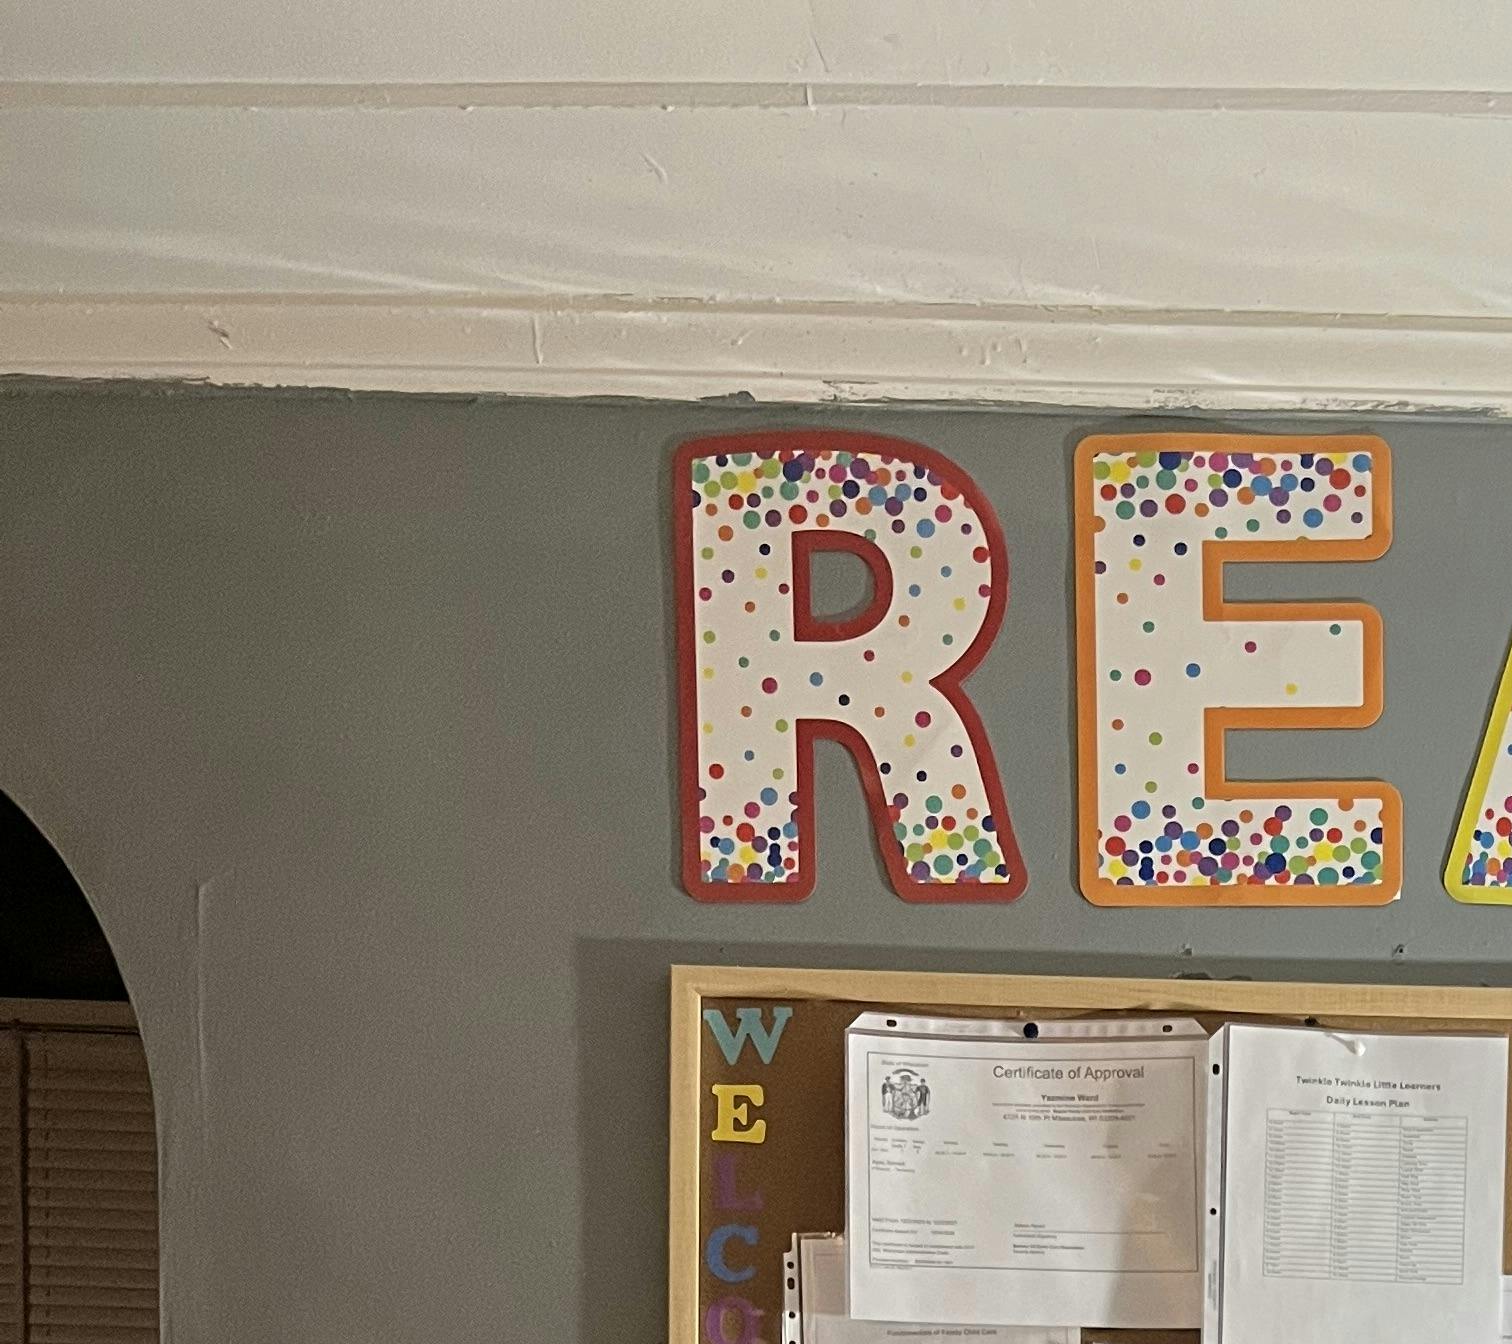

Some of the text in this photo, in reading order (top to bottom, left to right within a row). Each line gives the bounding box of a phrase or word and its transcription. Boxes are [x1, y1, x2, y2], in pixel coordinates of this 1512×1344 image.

[993, 1065, 1145, 1081] Certificate of Approval
[1297, 1076, 1440, 1090] Twinkle Twinkle Little Learners
[1326, 1096, 1410, 1108] Daily Lesson Plan
